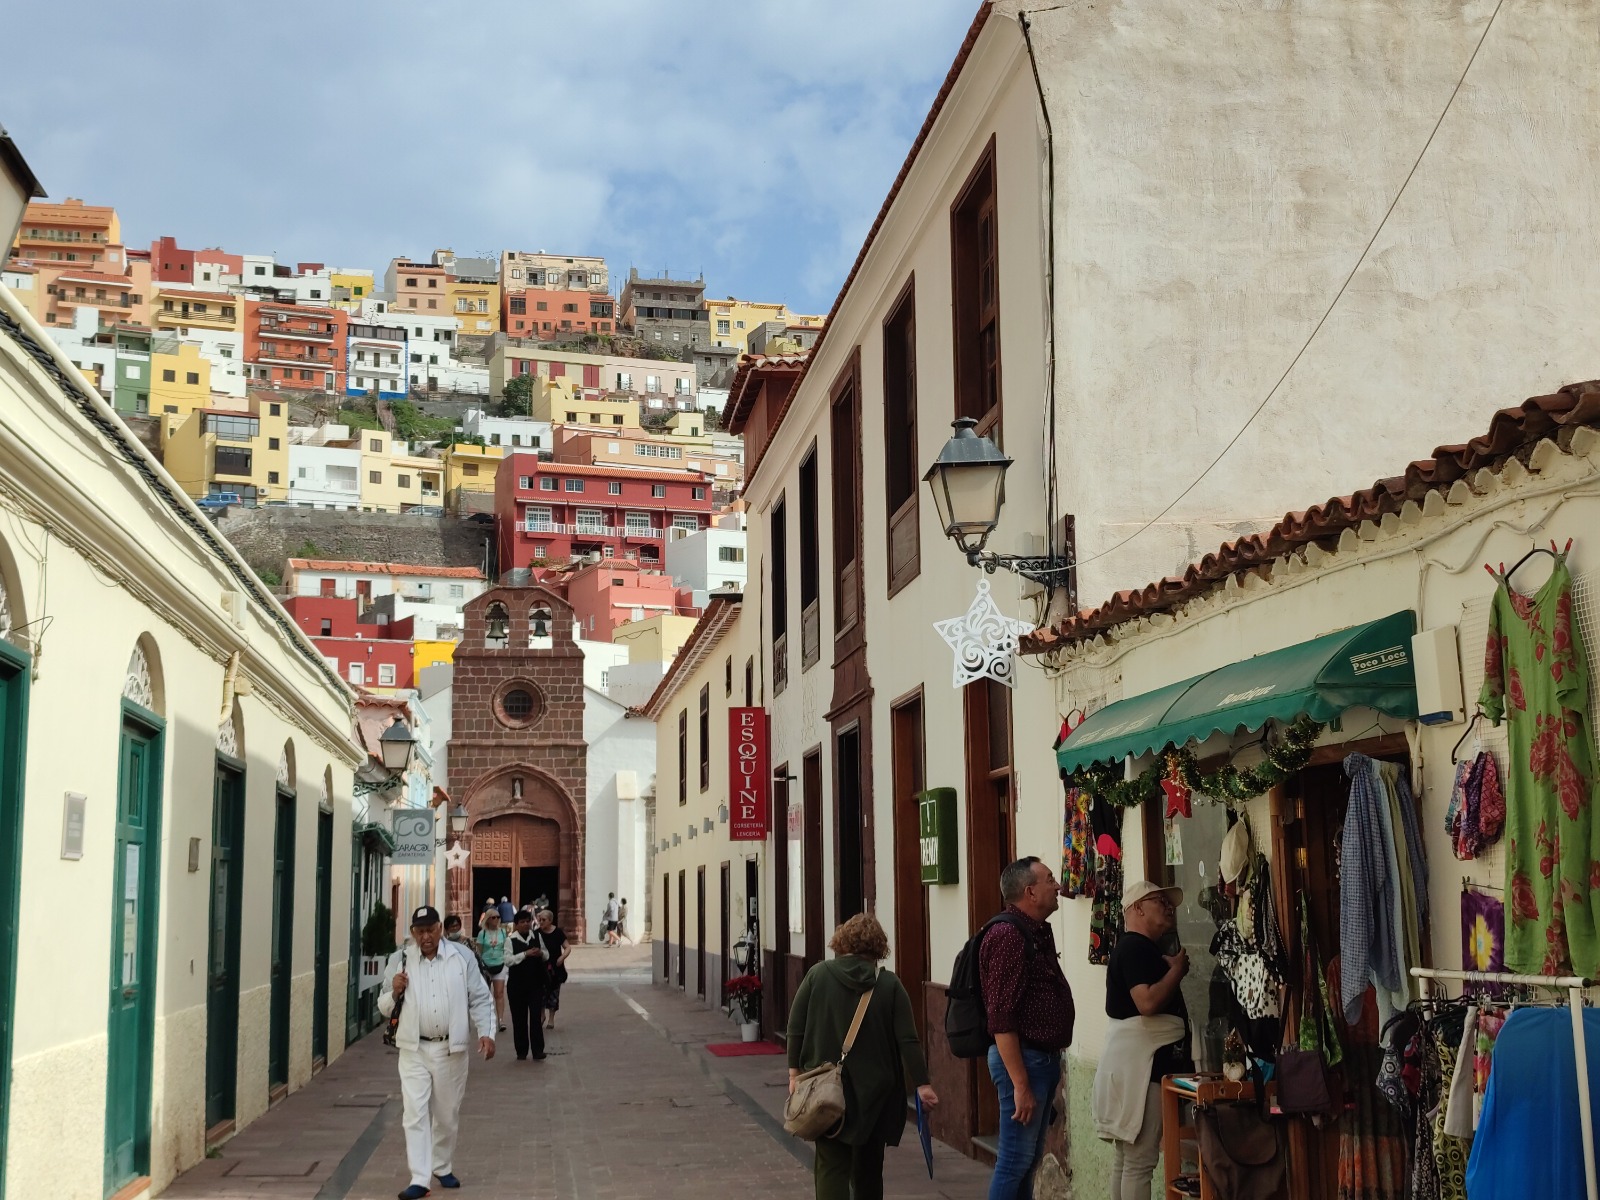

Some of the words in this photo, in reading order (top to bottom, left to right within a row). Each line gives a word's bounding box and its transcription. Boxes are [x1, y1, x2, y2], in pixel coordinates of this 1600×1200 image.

[1352, 659, 1378, 671] Poco
[1379, 651, 1406, 663] Loco
[737, 712, 758, 819] ESQUINE
